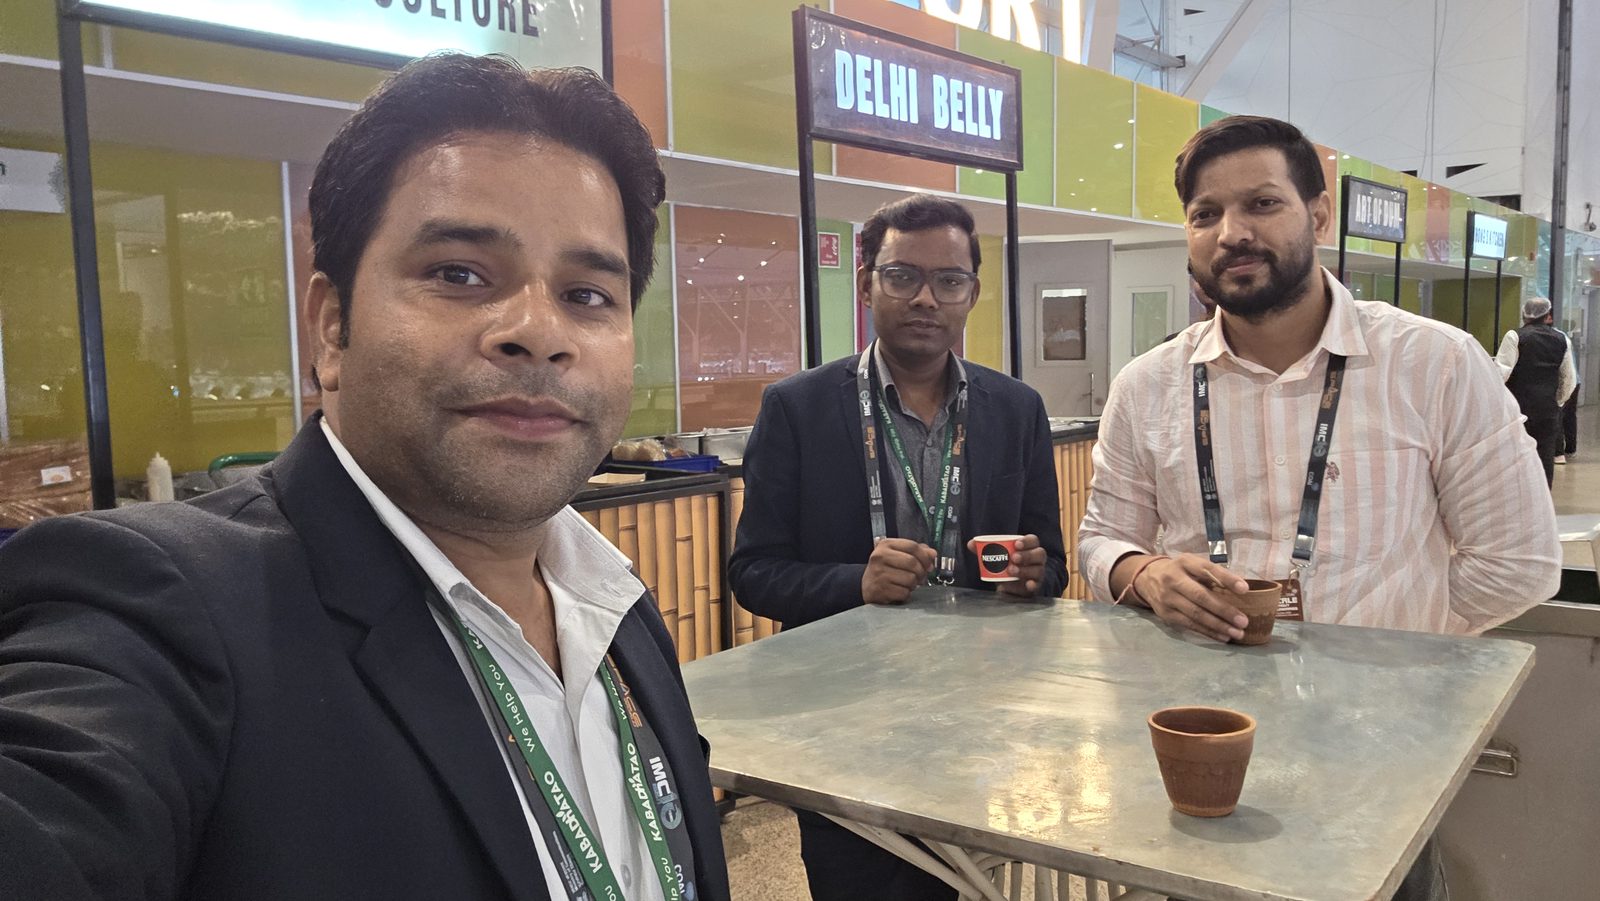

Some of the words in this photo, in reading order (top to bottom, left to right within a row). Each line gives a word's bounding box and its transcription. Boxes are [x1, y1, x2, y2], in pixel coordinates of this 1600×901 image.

[375, 0, 539, 38] LURE
[834, 49, 919, 124] DELHI
[932, 74, 1003, 140] BELLY
[489, 664, 505, 690] You
[505, 692, 524, 725] Help
[521, 727, 535, 752] We
[660, 857, 674, 883] You
